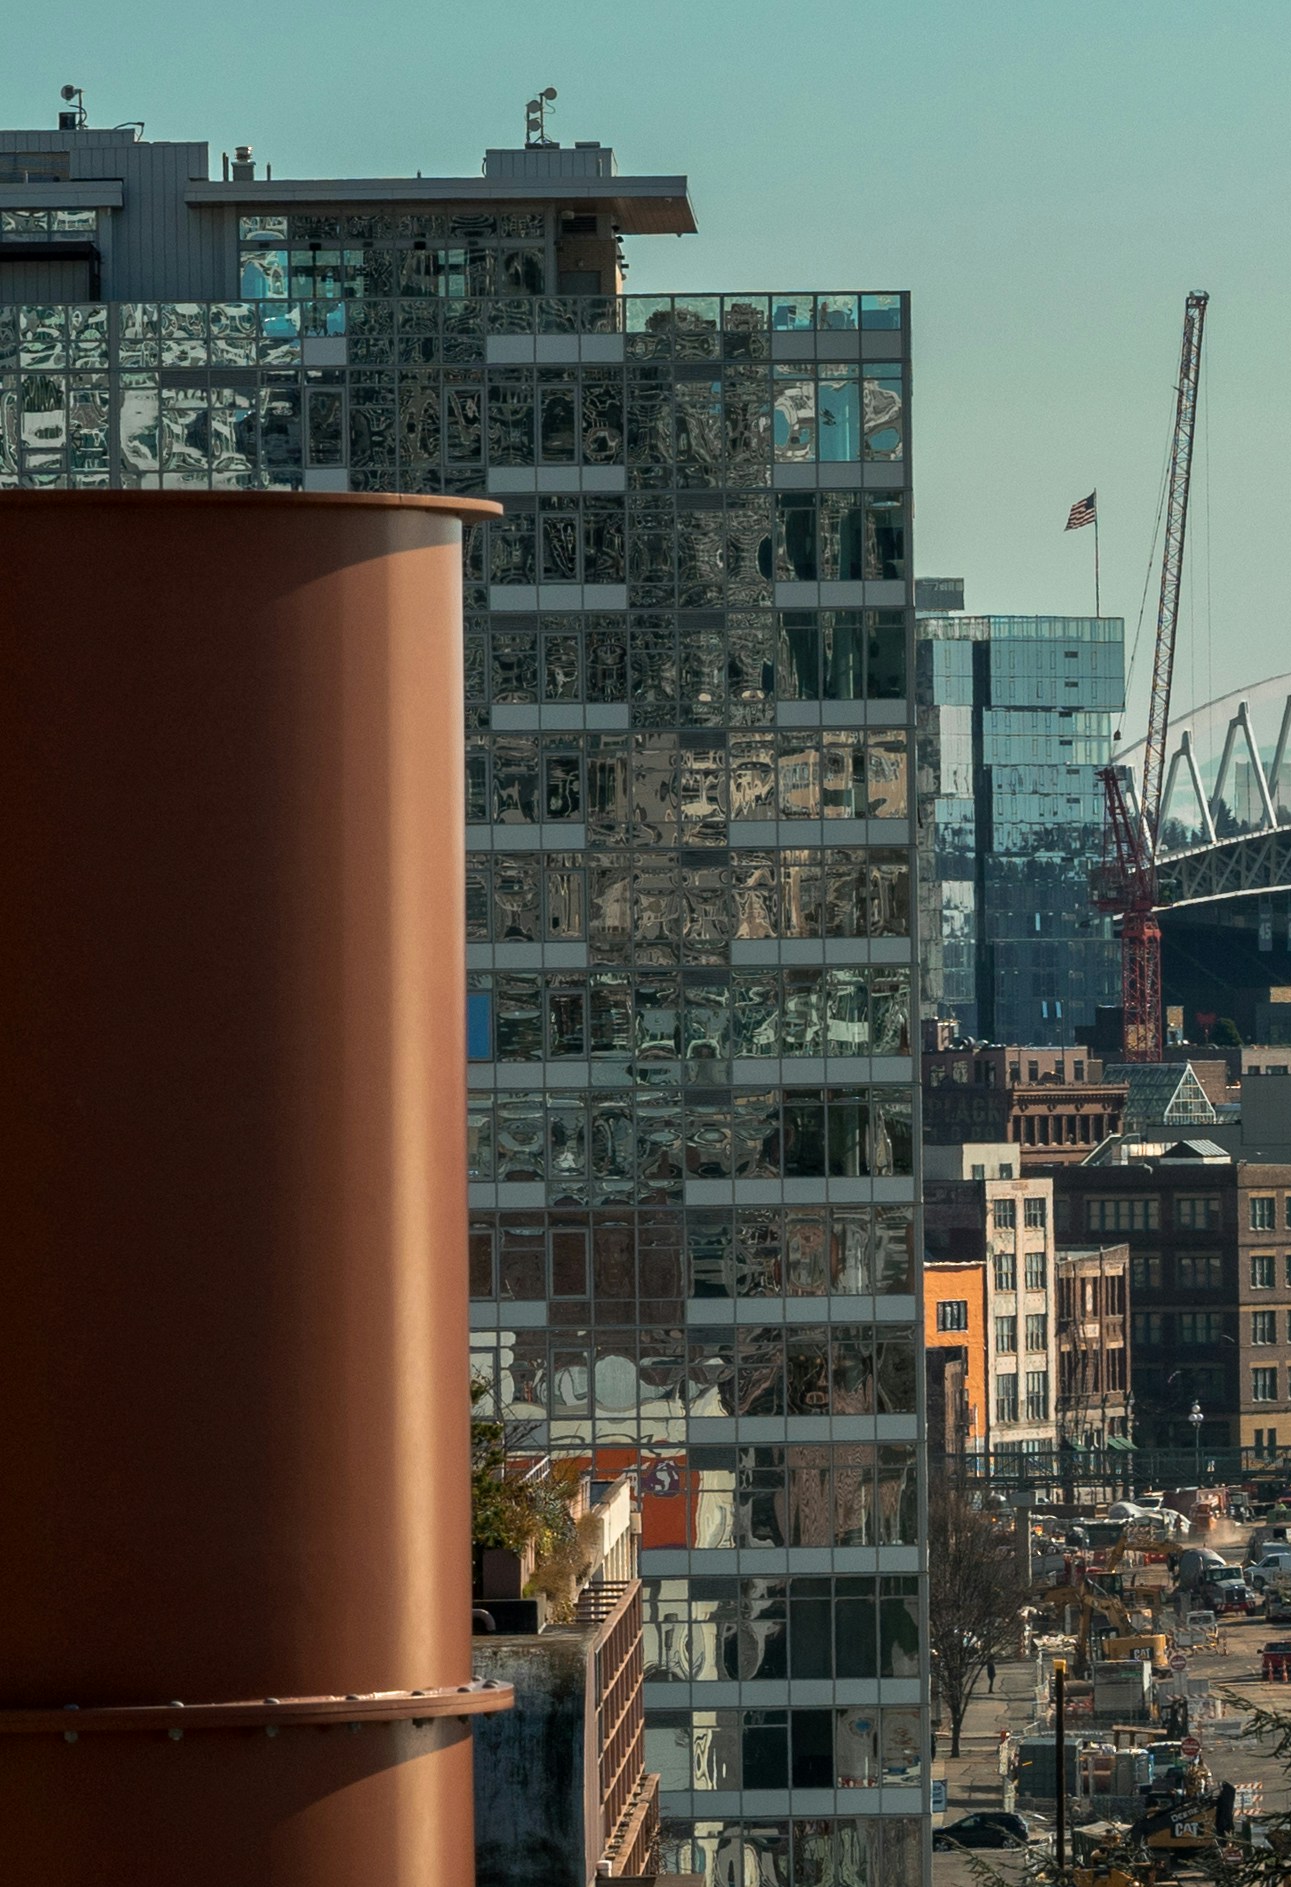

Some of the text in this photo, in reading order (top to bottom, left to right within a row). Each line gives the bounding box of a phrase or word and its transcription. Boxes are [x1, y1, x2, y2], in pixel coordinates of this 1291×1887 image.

[1258, 922, 1272, 940] 45
[1133, 1647, 1151, 1659] CAT
[1170, 1807, 1200, 1823] DEERE
[1175, 1822, 1199, 1837] CAT
